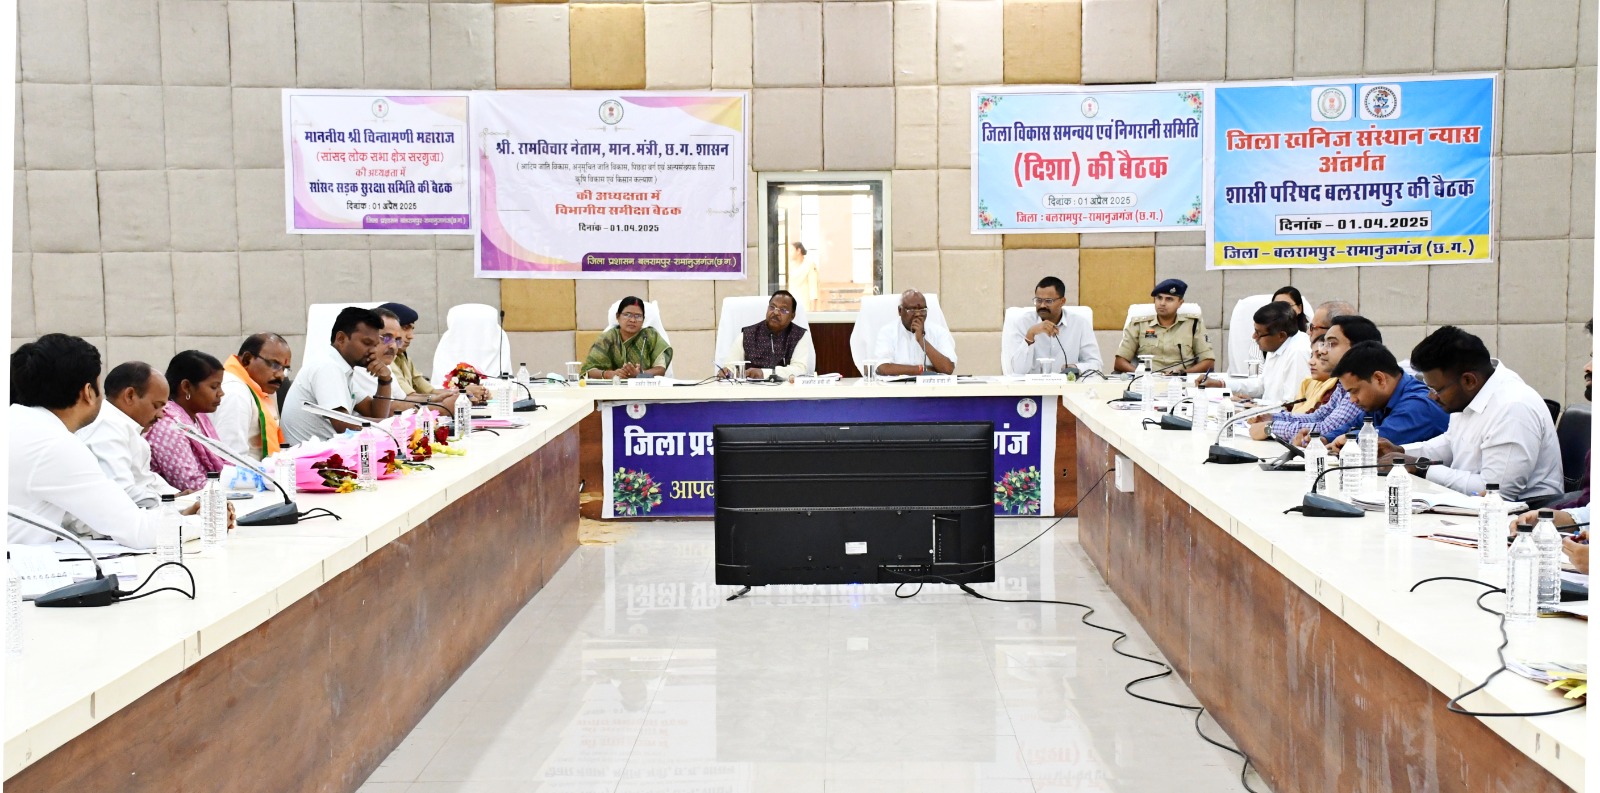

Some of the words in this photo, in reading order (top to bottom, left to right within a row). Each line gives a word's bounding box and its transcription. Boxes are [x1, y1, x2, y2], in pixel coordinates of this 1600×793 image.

[305, 129, 345, 143] माननीय
[348, 129, 360, 143] श्री
[364, 129, 414, 143] चिन्तामणी
[416, 131, 455, 143] महाराज
[982, 121, 1012, 142] जिला
[1014, 121, 1050, 141] विकास
[1053, 124, 1093, 141] समन्वय
[1096, 119, 1114, 140] एवं
[1115, 118, 1161, 139] निगरानी
[1163, 117, 1199, 139] समिति
[1226, 130, 1280, 151] जिला
[1284, 127, 1351, 148] खनिज
[1356, 124, 1424, 148] संस्थान
[1429, 126, 1481, 144] न्यास
[496, 139, 514, 156] श्री.
[518, 139, 567, 156] रामविचार
[571, 140, 605, 158] नेताम,
[696, 142, 729, 156] शासन
[316, 149, 346, 162] (सांसद
[348, 149, 367, 162] लोक
[370, 152, 388, 162] सभा
[391, 149, 406, 162] क्षेत्र
[408, 152, 444, 166] सरगुजा)
[1319, 150, 1386, 173] अंतर्गत
[356, 167, 366, 177] की
[1014, 151, 1081, 187] (दिशा)
[1087, 151, 1115, 181] की
[1117, 150, 1169, 179] बैठक
[309, 179, 334, 193] सांसद
[336, 182, 358, 196] सड़क
[361, 182, 385, 197] सुरक्षा
[388, 180, 415, 193] समिति
[418, 180, 429, 193] की
[431, 180, 452, 193] बैठक
[576, 190, 593, 201] की
[596, 192, 648, 201] अध्यक्षता
[650, 189, 662, 201] में
[1226, 181, 1267, 204] शासी
[1270, 180, 1321, 202] परिषद
[1325, 182, 1403, 207] बलरामपुर
[1407, 176, 1430, 199] की
[1431, 174, 1474, 199] बैठक
[1048, 195, 1072, 206] दिनांक
[1077, 197, 1088, 206] 01
[1090, 194, 1108, 205] अप्रैल
[1110, 196, 1131, 205] 2025
[555, 204, 606, 216] विभागीय
[608, 204, 650, 216] समीक्षा
[652, 204, 682, 216] बैठक
[1016, 211, 1038, 223] जिला
[1135, 209, 1164, 223] (छ.ग.)
[578, 222, 601, 232] दिनांक
[610, 224, 659, 232] 01.04.2025
[1279, 217, 1321, 231] दिनांक
[1338, 217, 1429, 230] 01.04.2025
[1224, 246, 1259, 260] जिला
[1426, 239, 1475, 257] (छ.ग.)
[587, 255, 605, 265] जिला
[608, 257, 635, 266] प्रशासन
[624, 425, 687, 456] जिला
